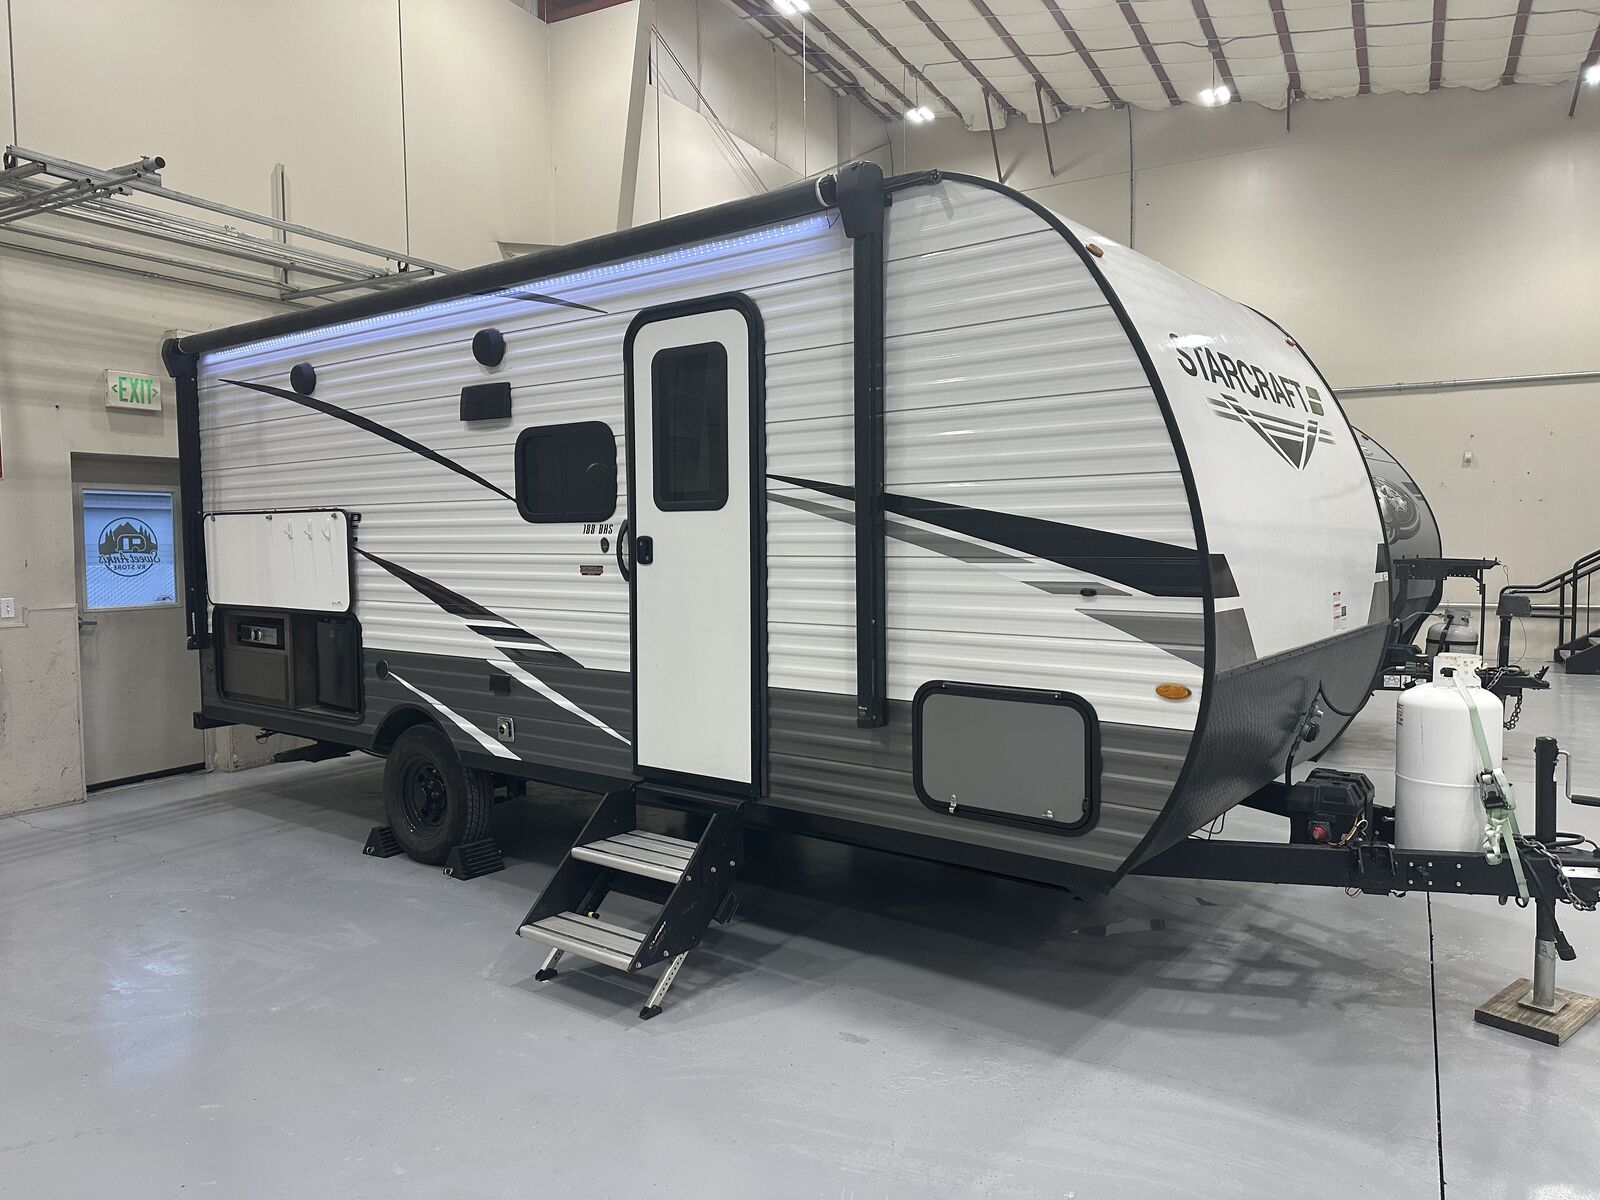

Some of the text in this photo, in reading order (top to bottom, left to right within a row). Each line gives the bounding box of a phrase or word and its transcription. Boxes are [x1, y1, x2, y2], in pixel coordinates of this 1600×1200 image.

[1169, 332, 1309, 413] STARCRAFT
[118, 376, 153, 404] EXIT
[598, 524, 614, 535] BHS
